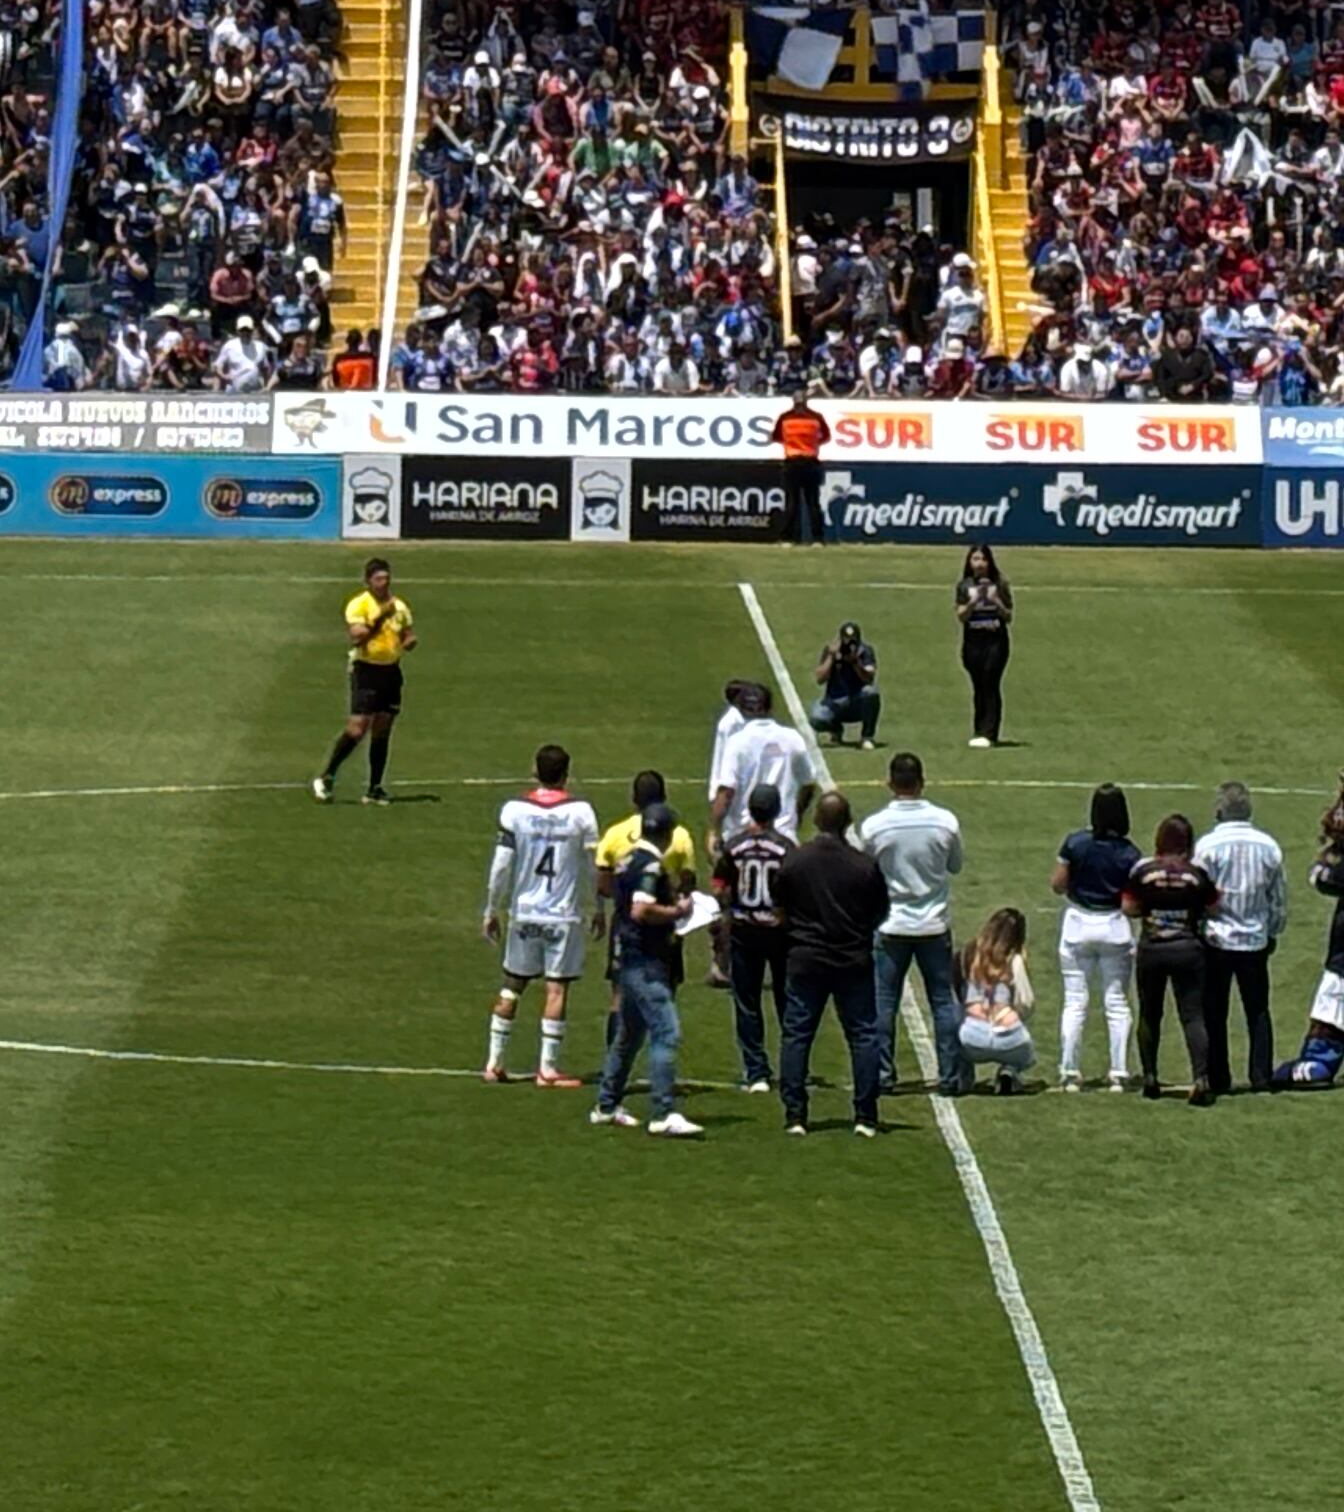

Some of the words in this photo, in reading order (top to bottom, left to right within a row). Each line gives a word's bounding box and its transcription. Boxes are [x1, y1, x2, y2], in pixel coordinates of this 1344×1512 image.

[437, 405, 543, 444] San
[567, 408, 774, 447] Marcos
[835, 418, 923, 450] SUR
[985, 420, 1077, 452] SUR
[1137, 421, 1228, 453] SUR
[93, 486, 162, 506] express
[247, 488, 315, 507] express
[412, 481, 559, 509] HARIANA
[642, 485, 785, 513] HARIANA
[843, 494, 1012, 535] medismart
[1075, 495, 1242, 537] medismart
[535, 845, 557, 894] 4
